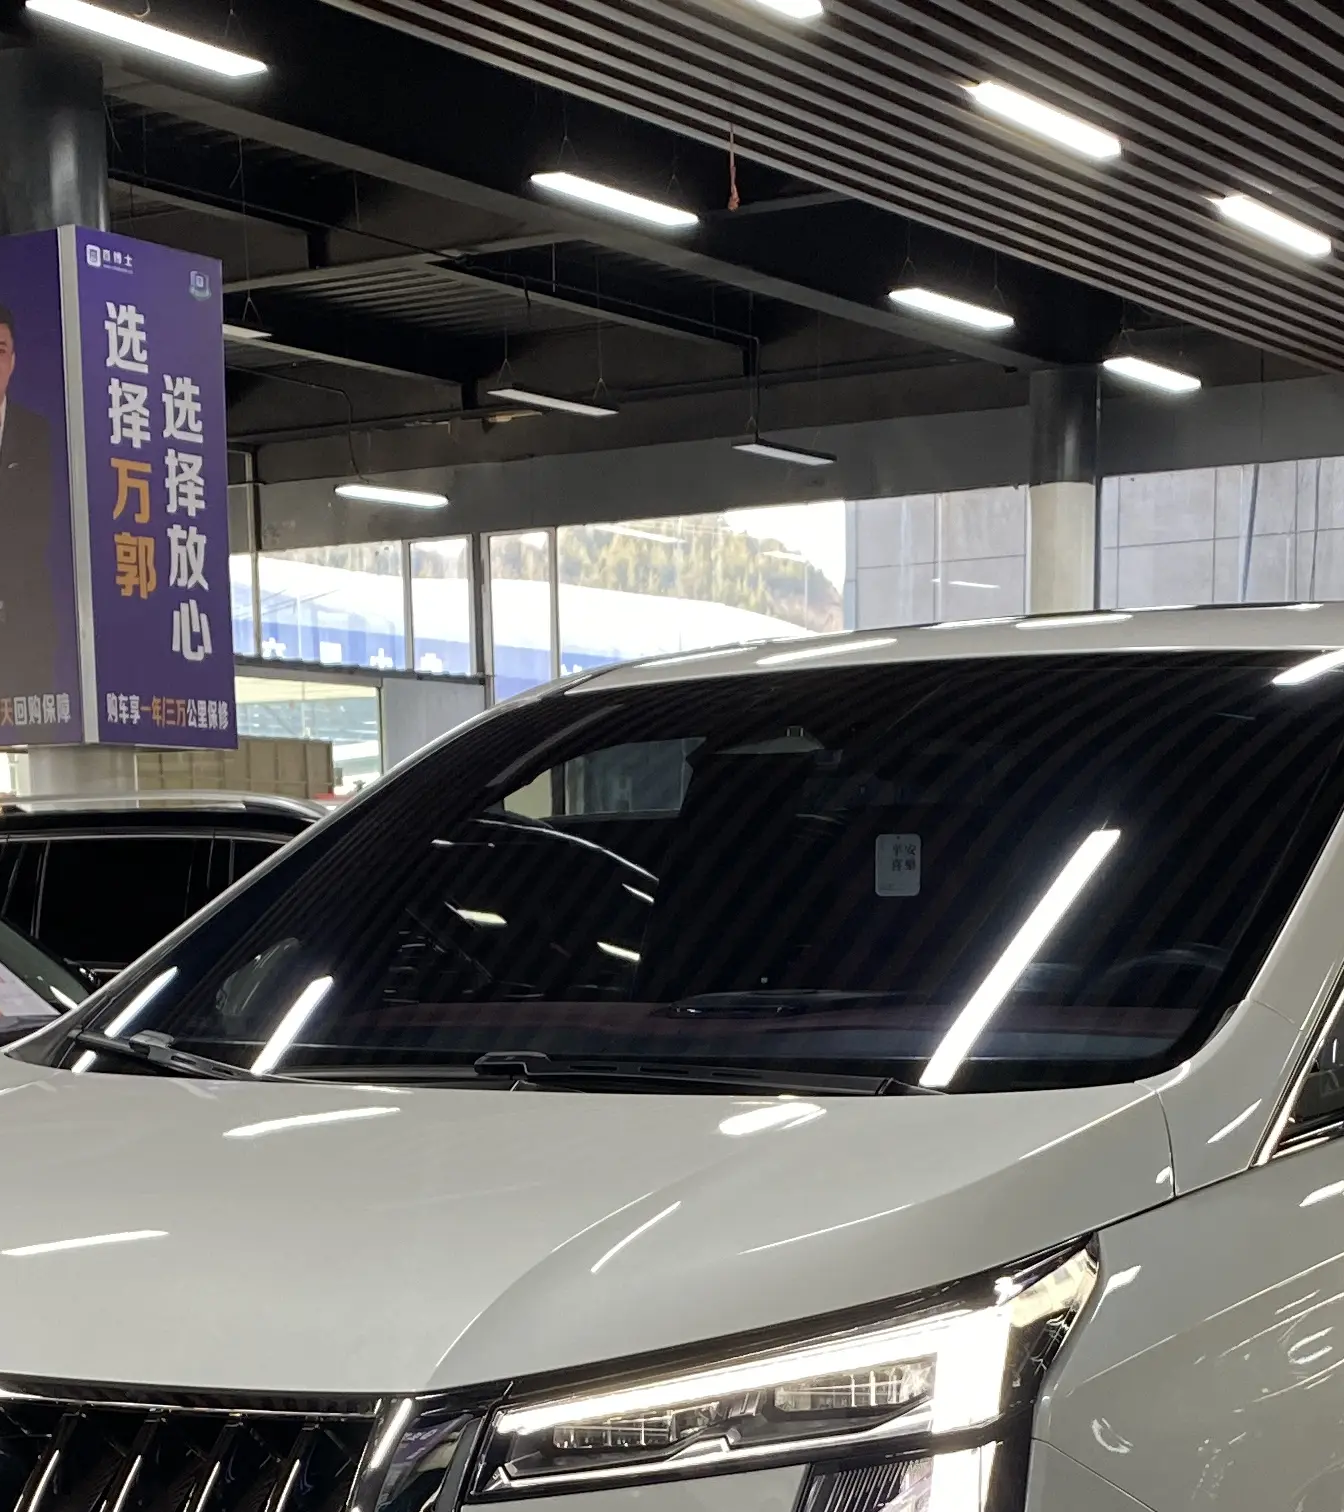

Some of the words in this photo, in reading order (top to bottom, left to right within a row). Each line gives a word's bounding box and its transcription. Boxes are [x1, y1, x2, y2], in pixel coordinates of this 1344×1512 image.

[105, 301, 156, 600] 选择万郭
[161, 373, 213, 662] 选择放心
